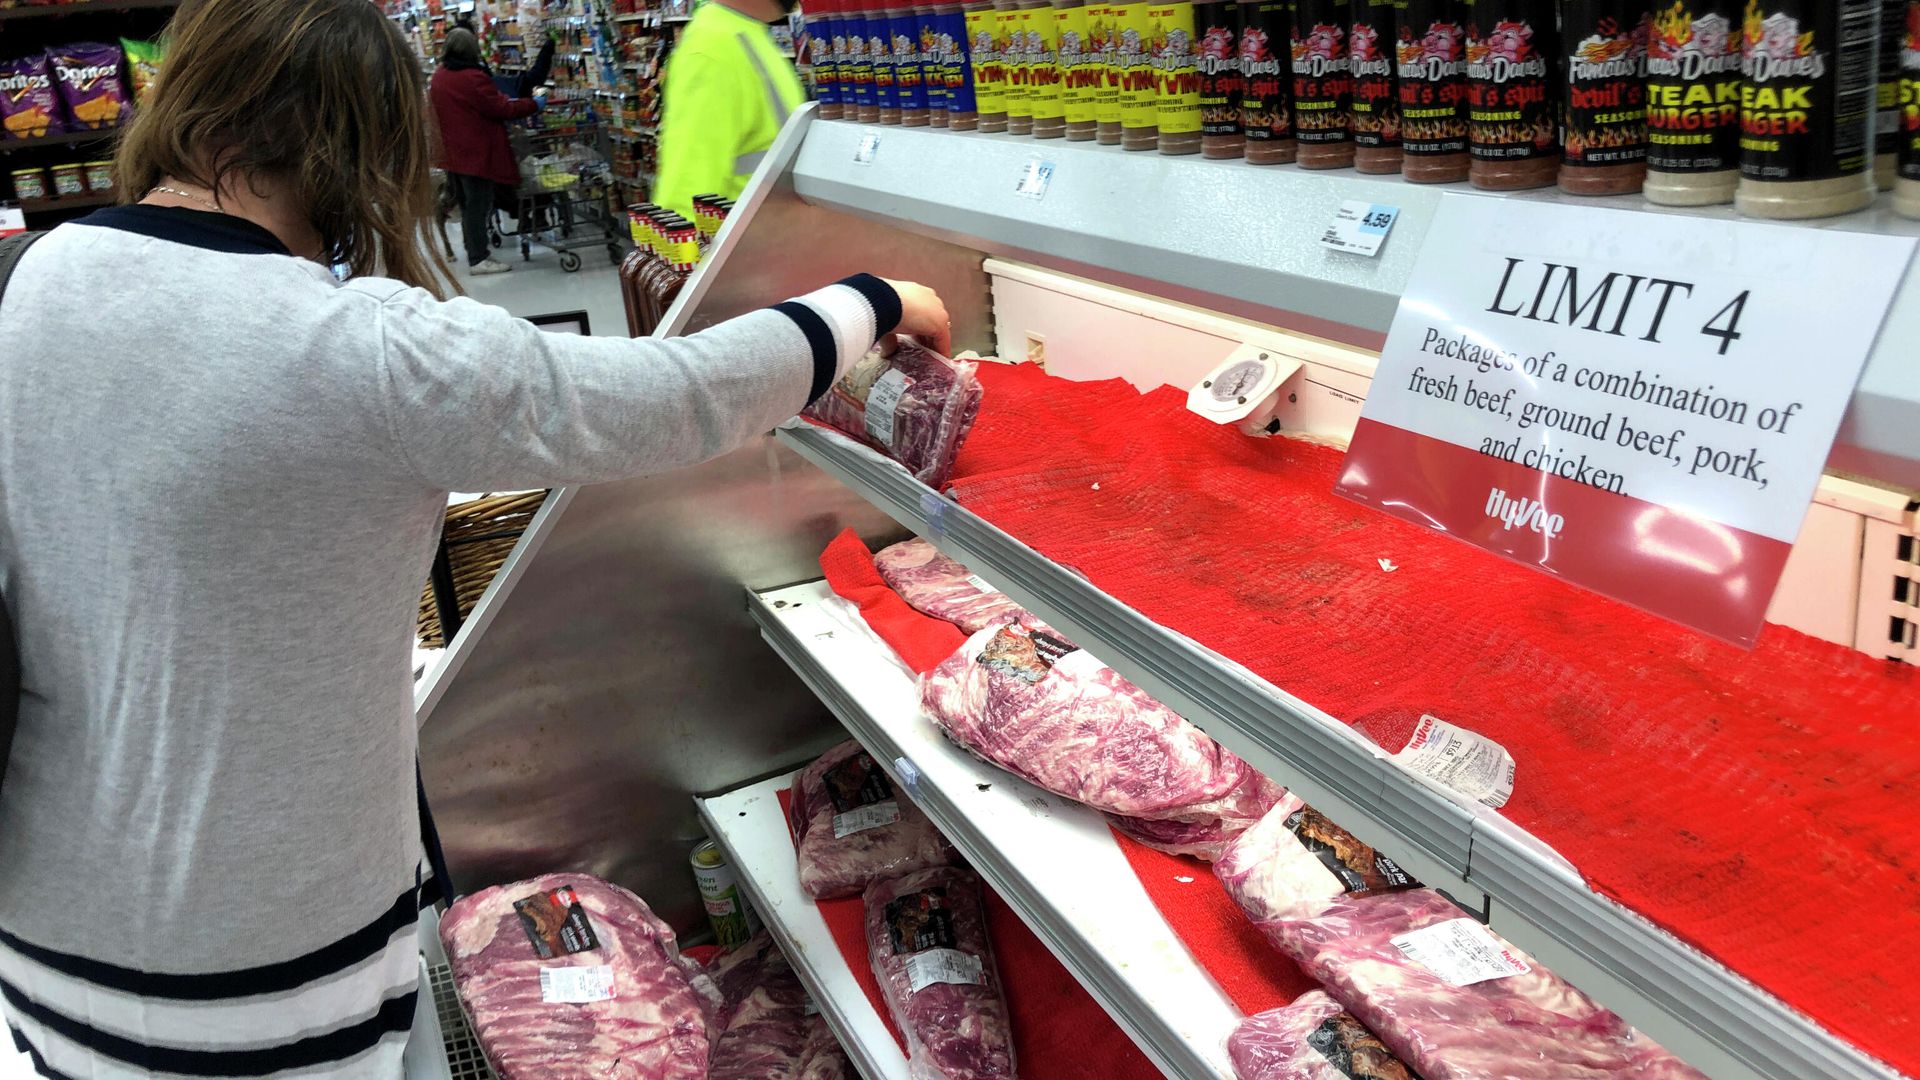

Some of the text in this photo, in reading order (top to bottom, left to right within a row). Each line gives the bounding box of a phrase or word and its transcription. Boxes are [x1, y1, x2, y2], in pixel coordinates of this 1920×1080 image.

[0, 69, 51, 91] oritos
[55, 63, 117, 82] Doritos
[1647, 80, 1742, 106] TEAK
[1741, 85, 1815, 109] EAK
[1363, 211, 1392, 229] 4.59
[1484, 256, 1752, 356] LIMIT 4
[1420, 326, 1803, 435] Packages of a combination of
[1407, 366, 1769, 491] fresh beef, ground beef, pork,
[1479, 436, 1629, 498] and chicken.
